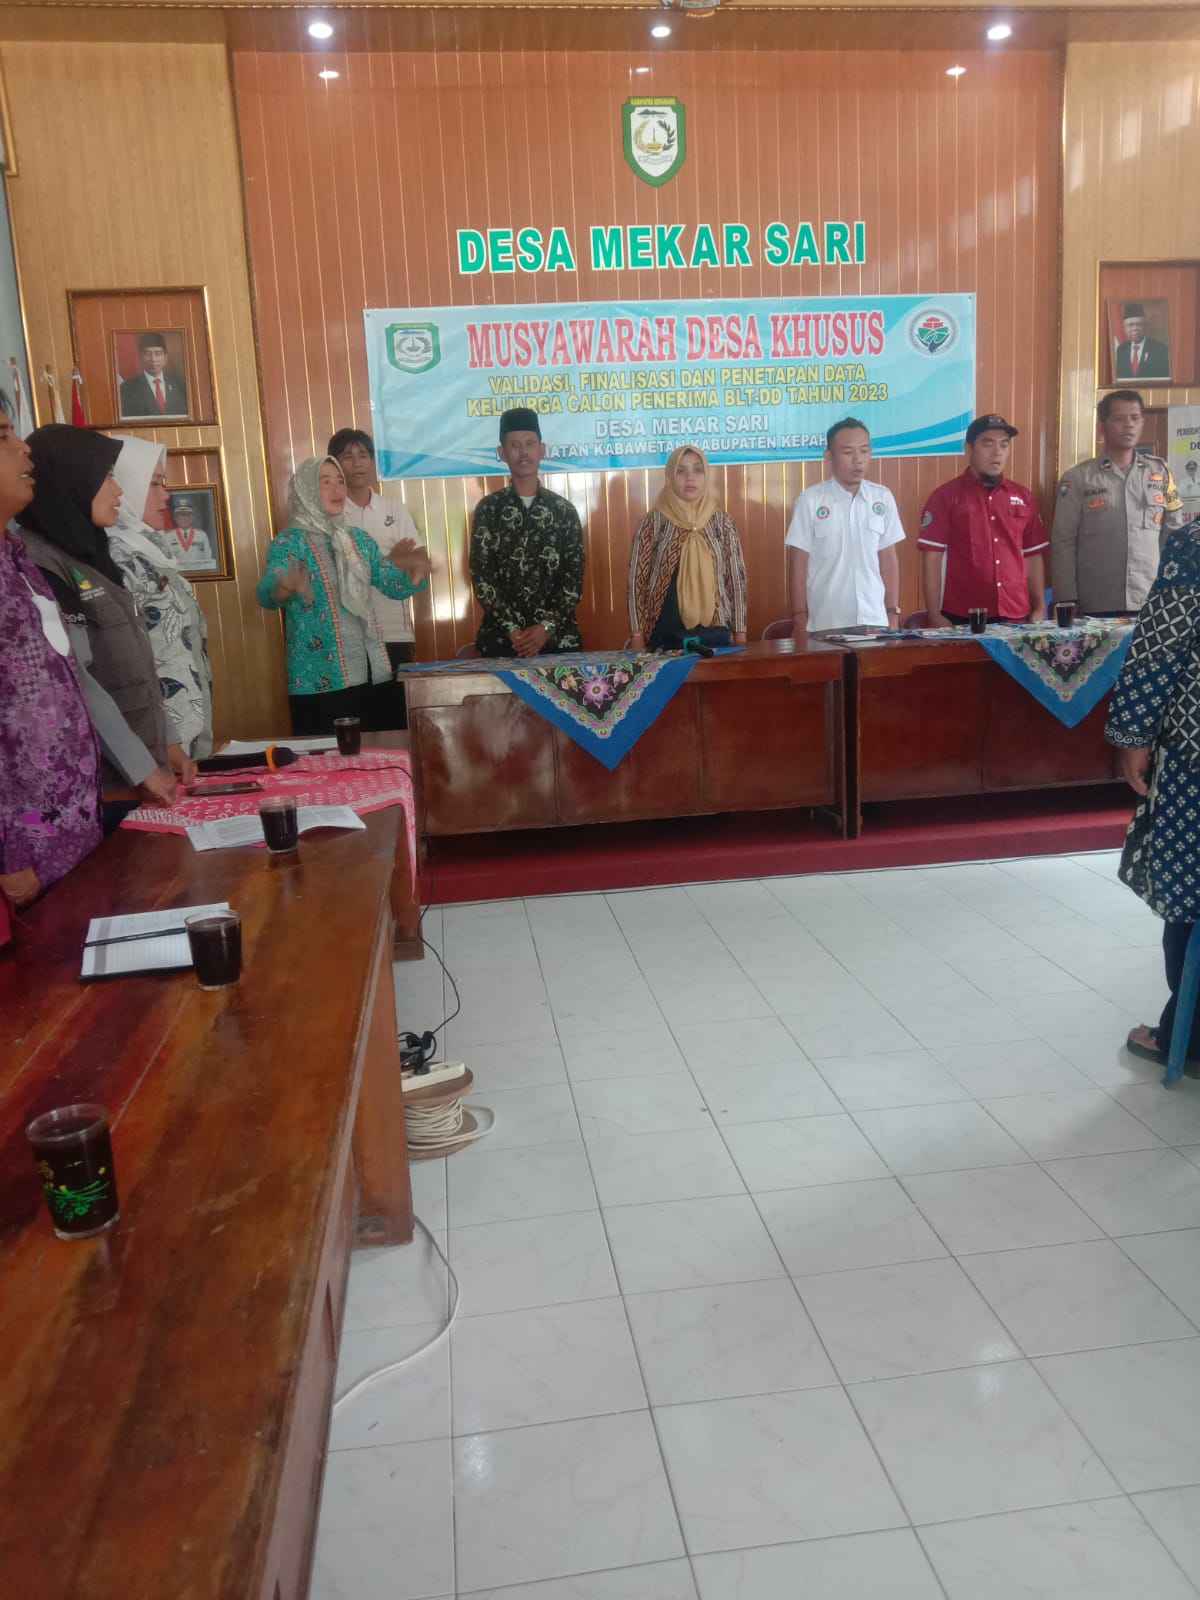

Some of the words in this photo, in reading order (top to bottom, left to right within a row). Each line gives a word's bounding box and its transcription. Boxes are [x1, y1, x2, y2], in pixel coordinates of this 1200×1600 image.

[456, 227, 576, 274] DESA
[589, 223, 752, 270] MEKAR
[764, 221, 866, 267] SARI
[467, 316, 677, 368] MUSYAWARAH
[685, 315, 763, 361] DESA
[770, 312, 884, 358] KHUSUS
[488, 373, 576, 395] VALIDASI,
[579, 370, 676, 391] FINALISASI
[681, 367, 716, 388] DAN
[720, 364, 821, 386] PENETAPAN
[824, 362, 866, 383] DATA
[467, 396, 563, 417] KELUARGA
[567, 391, 626, 412] CALON
[631, 388, 720, 409] PENERIMA
[724, 387, 783, 407] BLT-DD
[786, 384, 844, 405] TAHUN
[847, 383, 888, 402] 2023
[595, 418, 647, 439] DESA
[652, 415, 720, 436] MEKAR
[725, 413, 769, 433] SARI
[781, 434, 828, 448] KEPAH
